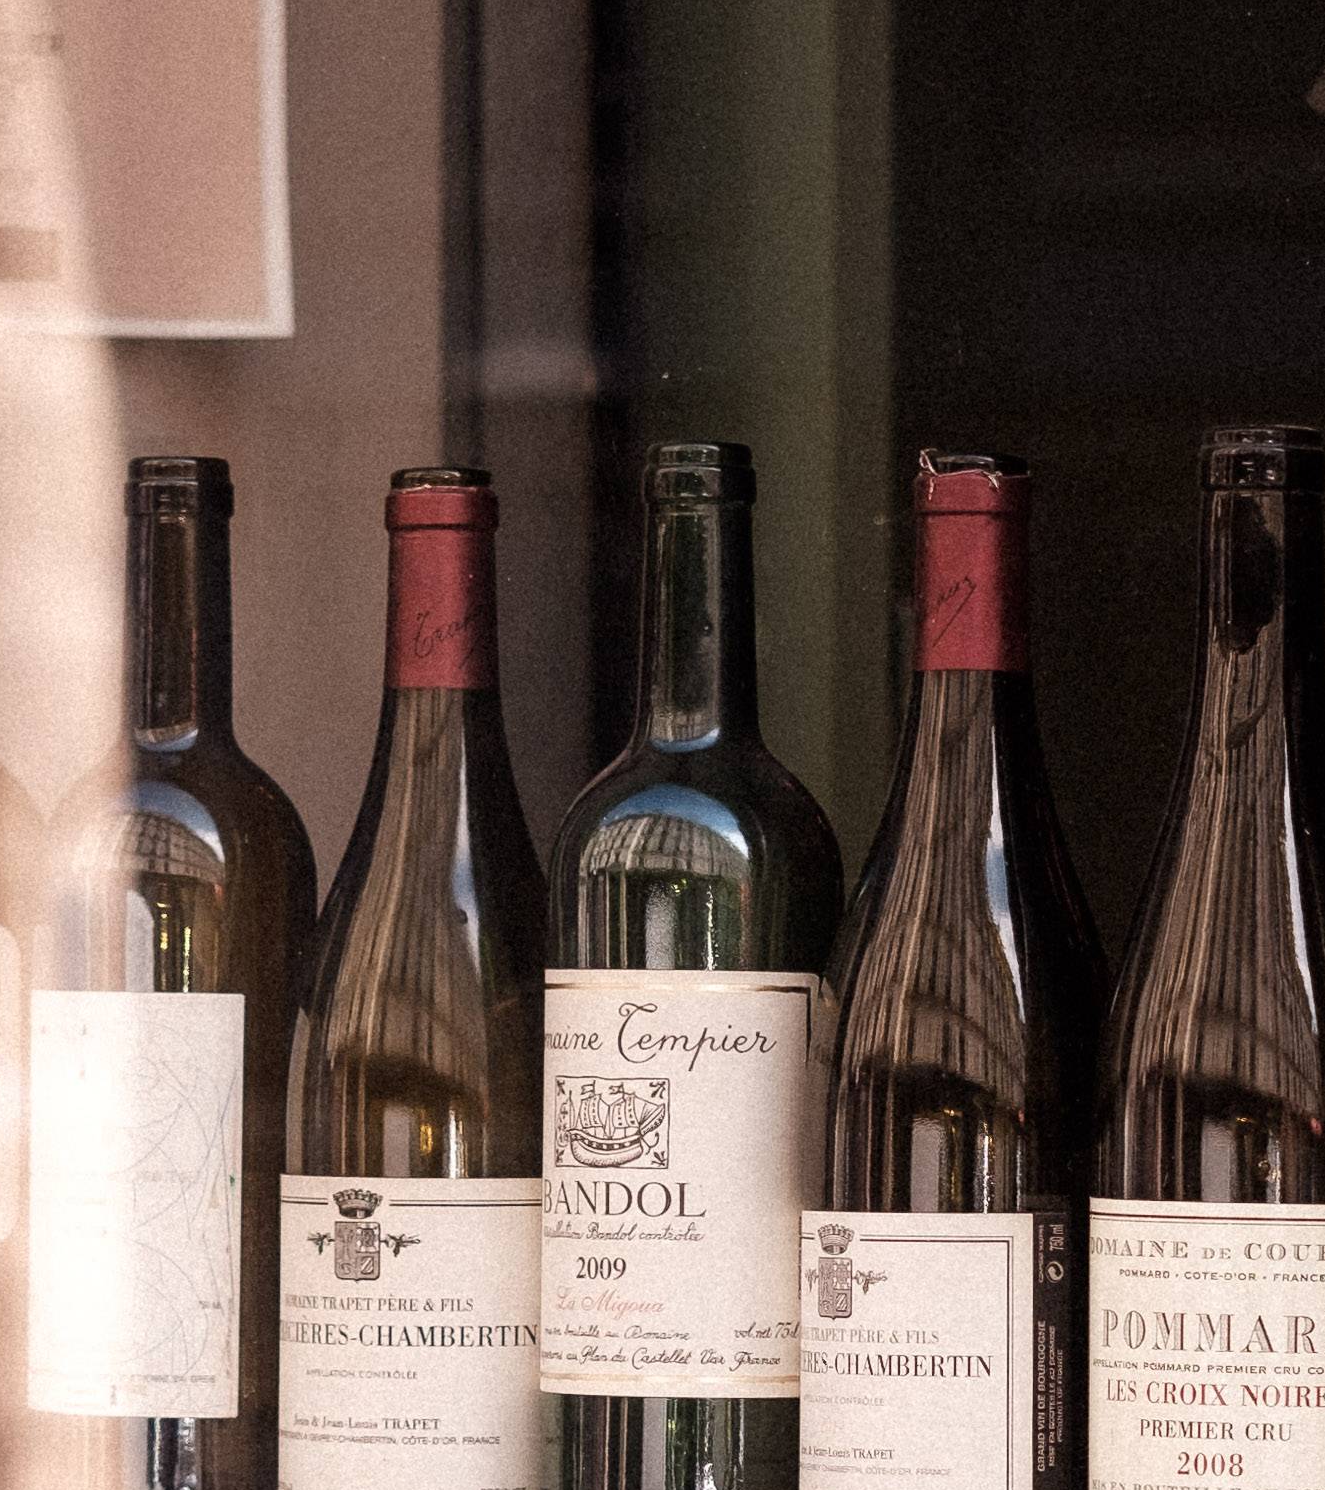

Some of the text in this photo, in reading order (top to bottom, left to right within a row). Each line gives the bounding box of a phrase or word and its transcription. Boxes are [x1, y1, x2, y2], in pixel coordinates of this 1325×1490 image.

[618, 1002, 777, 1072] Tempier
[544, 1180, 707, 1218] BANDOL
[586, 1221, 638, 1241] Bandol
[1050, 1235, 1064, 1252] 750
[576, 1256, 627, 1280] 2009
[1119, 1269, 1170, 1279] POMMARD
[321, 1293, 474, 1312] TRAPET PÈRE & FILS
[808, 1327, 846, 1343] TRAPET
[850, 1324, 885, 1344] PÈRE
[889, 1331, 900, 1344] &
[905, 1330, 940, 1345] FILS
[631, 1347, 692, 1370] Castellet
[1143, 1362, 1201, 1373] POMMARD
[1207, 1364, 1267, 1375] PREMIER
[1274, 1366, 1301, 1375] CRU
[1037, 1320, 1046, 1472] GRAND VIN DE BOURGOGNE
[1106, 1378, 1138, 1403] LES
[1146, 1381, 1228, 1406] CROIX
[382, 1418, 440, 1430] TRAPET
[1139, 1418, 1293, 1442] PREMIER CRU
[462, 1436, 501, 1445] FRANCE
[852, 1447, 895, 1460] TRAPET
[1177, 1451, 1245, 1477] 2008
